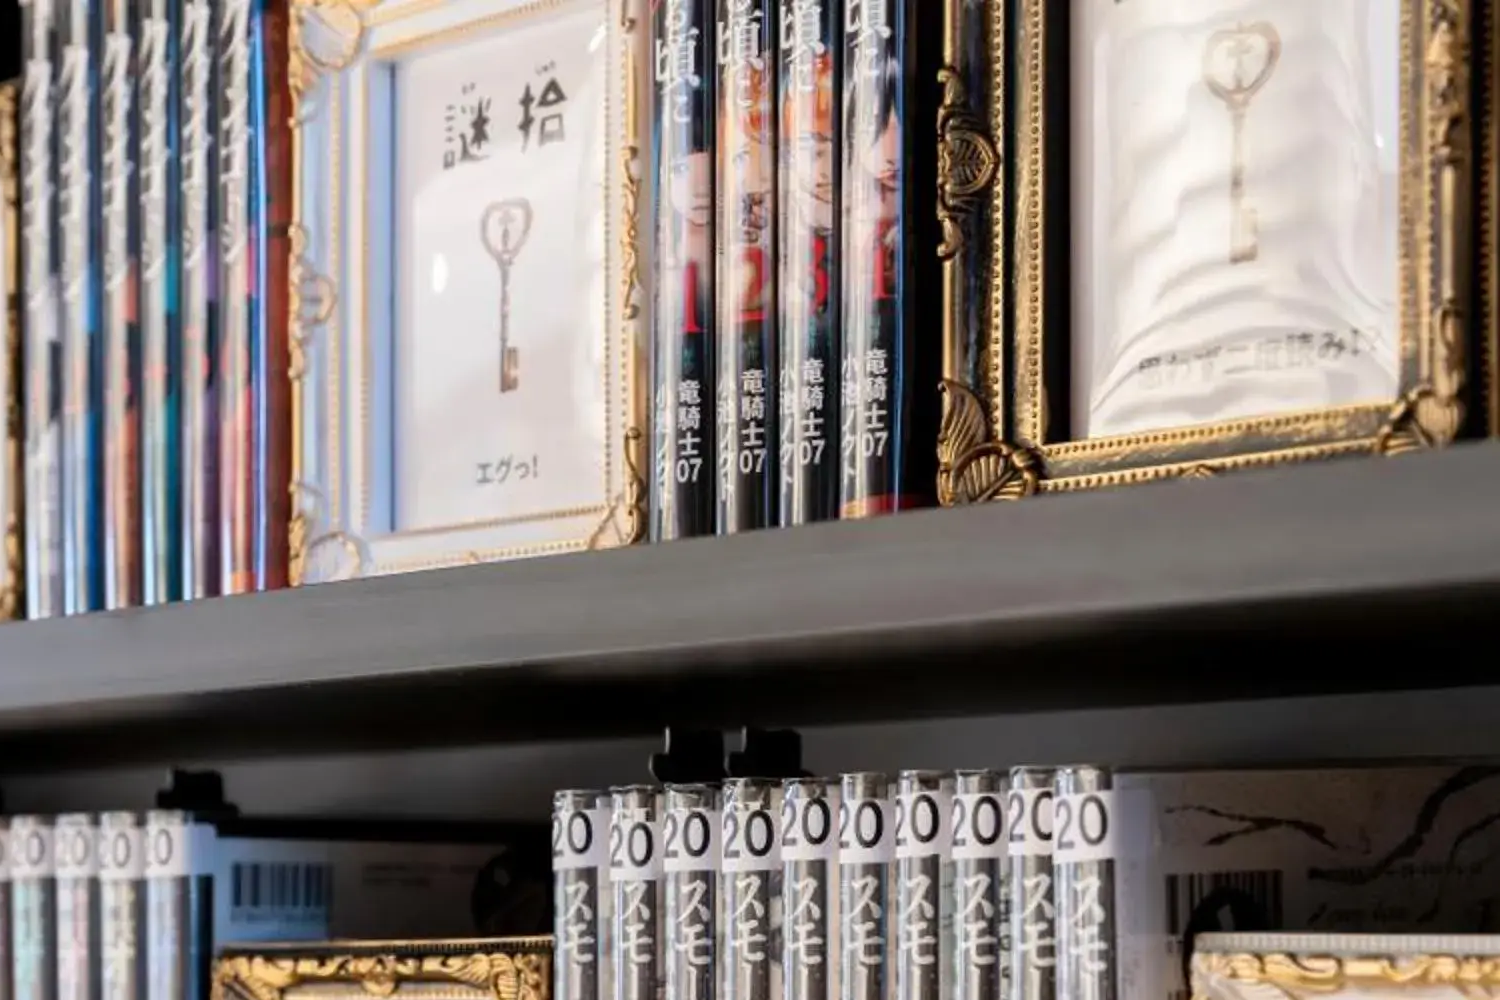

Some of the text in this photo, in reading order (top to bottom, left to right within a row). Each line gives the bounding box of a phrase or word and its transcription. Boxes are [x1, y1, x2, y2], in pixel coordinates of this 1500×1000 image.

[552, 810, 593, 856] 20
[663, 810, 711, 858] 20
[722, 809, 775, 858] 20
[781, 797, 831, 846] 20
[839, 800, 884, 848] 20
[952, 795, 1002, 847] 20
[1009, 790, 1052, 841] 20
[1055, 795, 1108, 850] 20
[610, 821, 654, 868] 20
